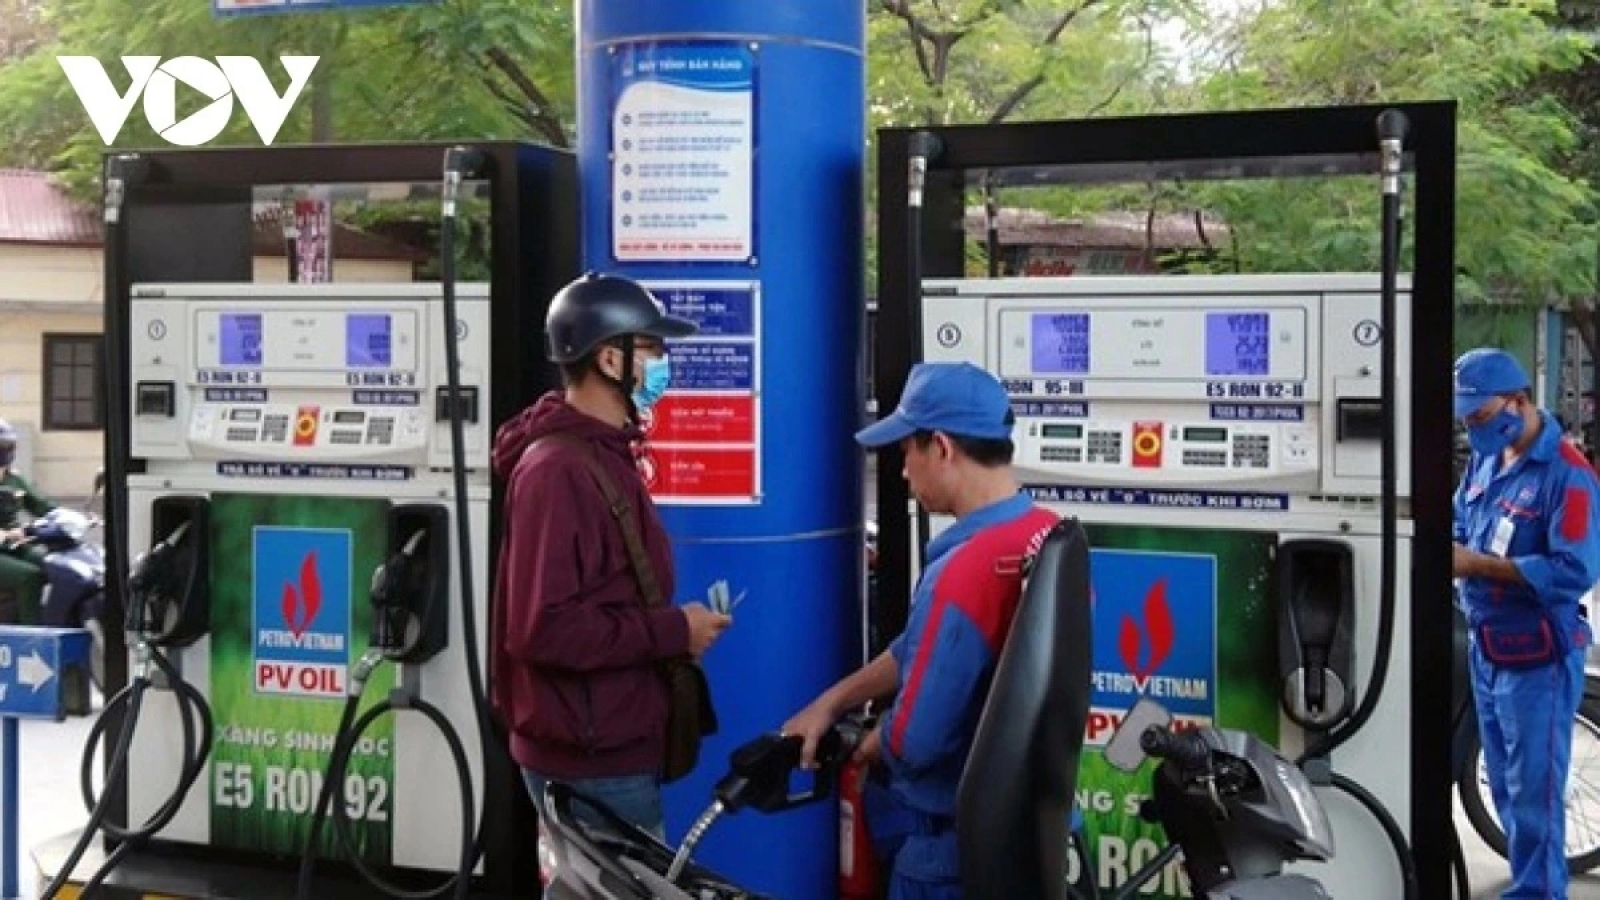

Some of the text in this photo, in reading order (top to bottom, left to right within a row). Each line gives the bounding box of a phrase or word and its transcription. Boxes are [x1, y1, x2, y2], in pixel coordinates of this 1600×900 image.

[1206, 382, 1226, 397] E5
[1229, 382, 1261, 397] RON
[258, 630, 344, 650] PETROVIETNAM
[258, 664, 342, 693] PV OIL
[215, 761, 254, 809] E5
[344, 775, 387, 822] 92
